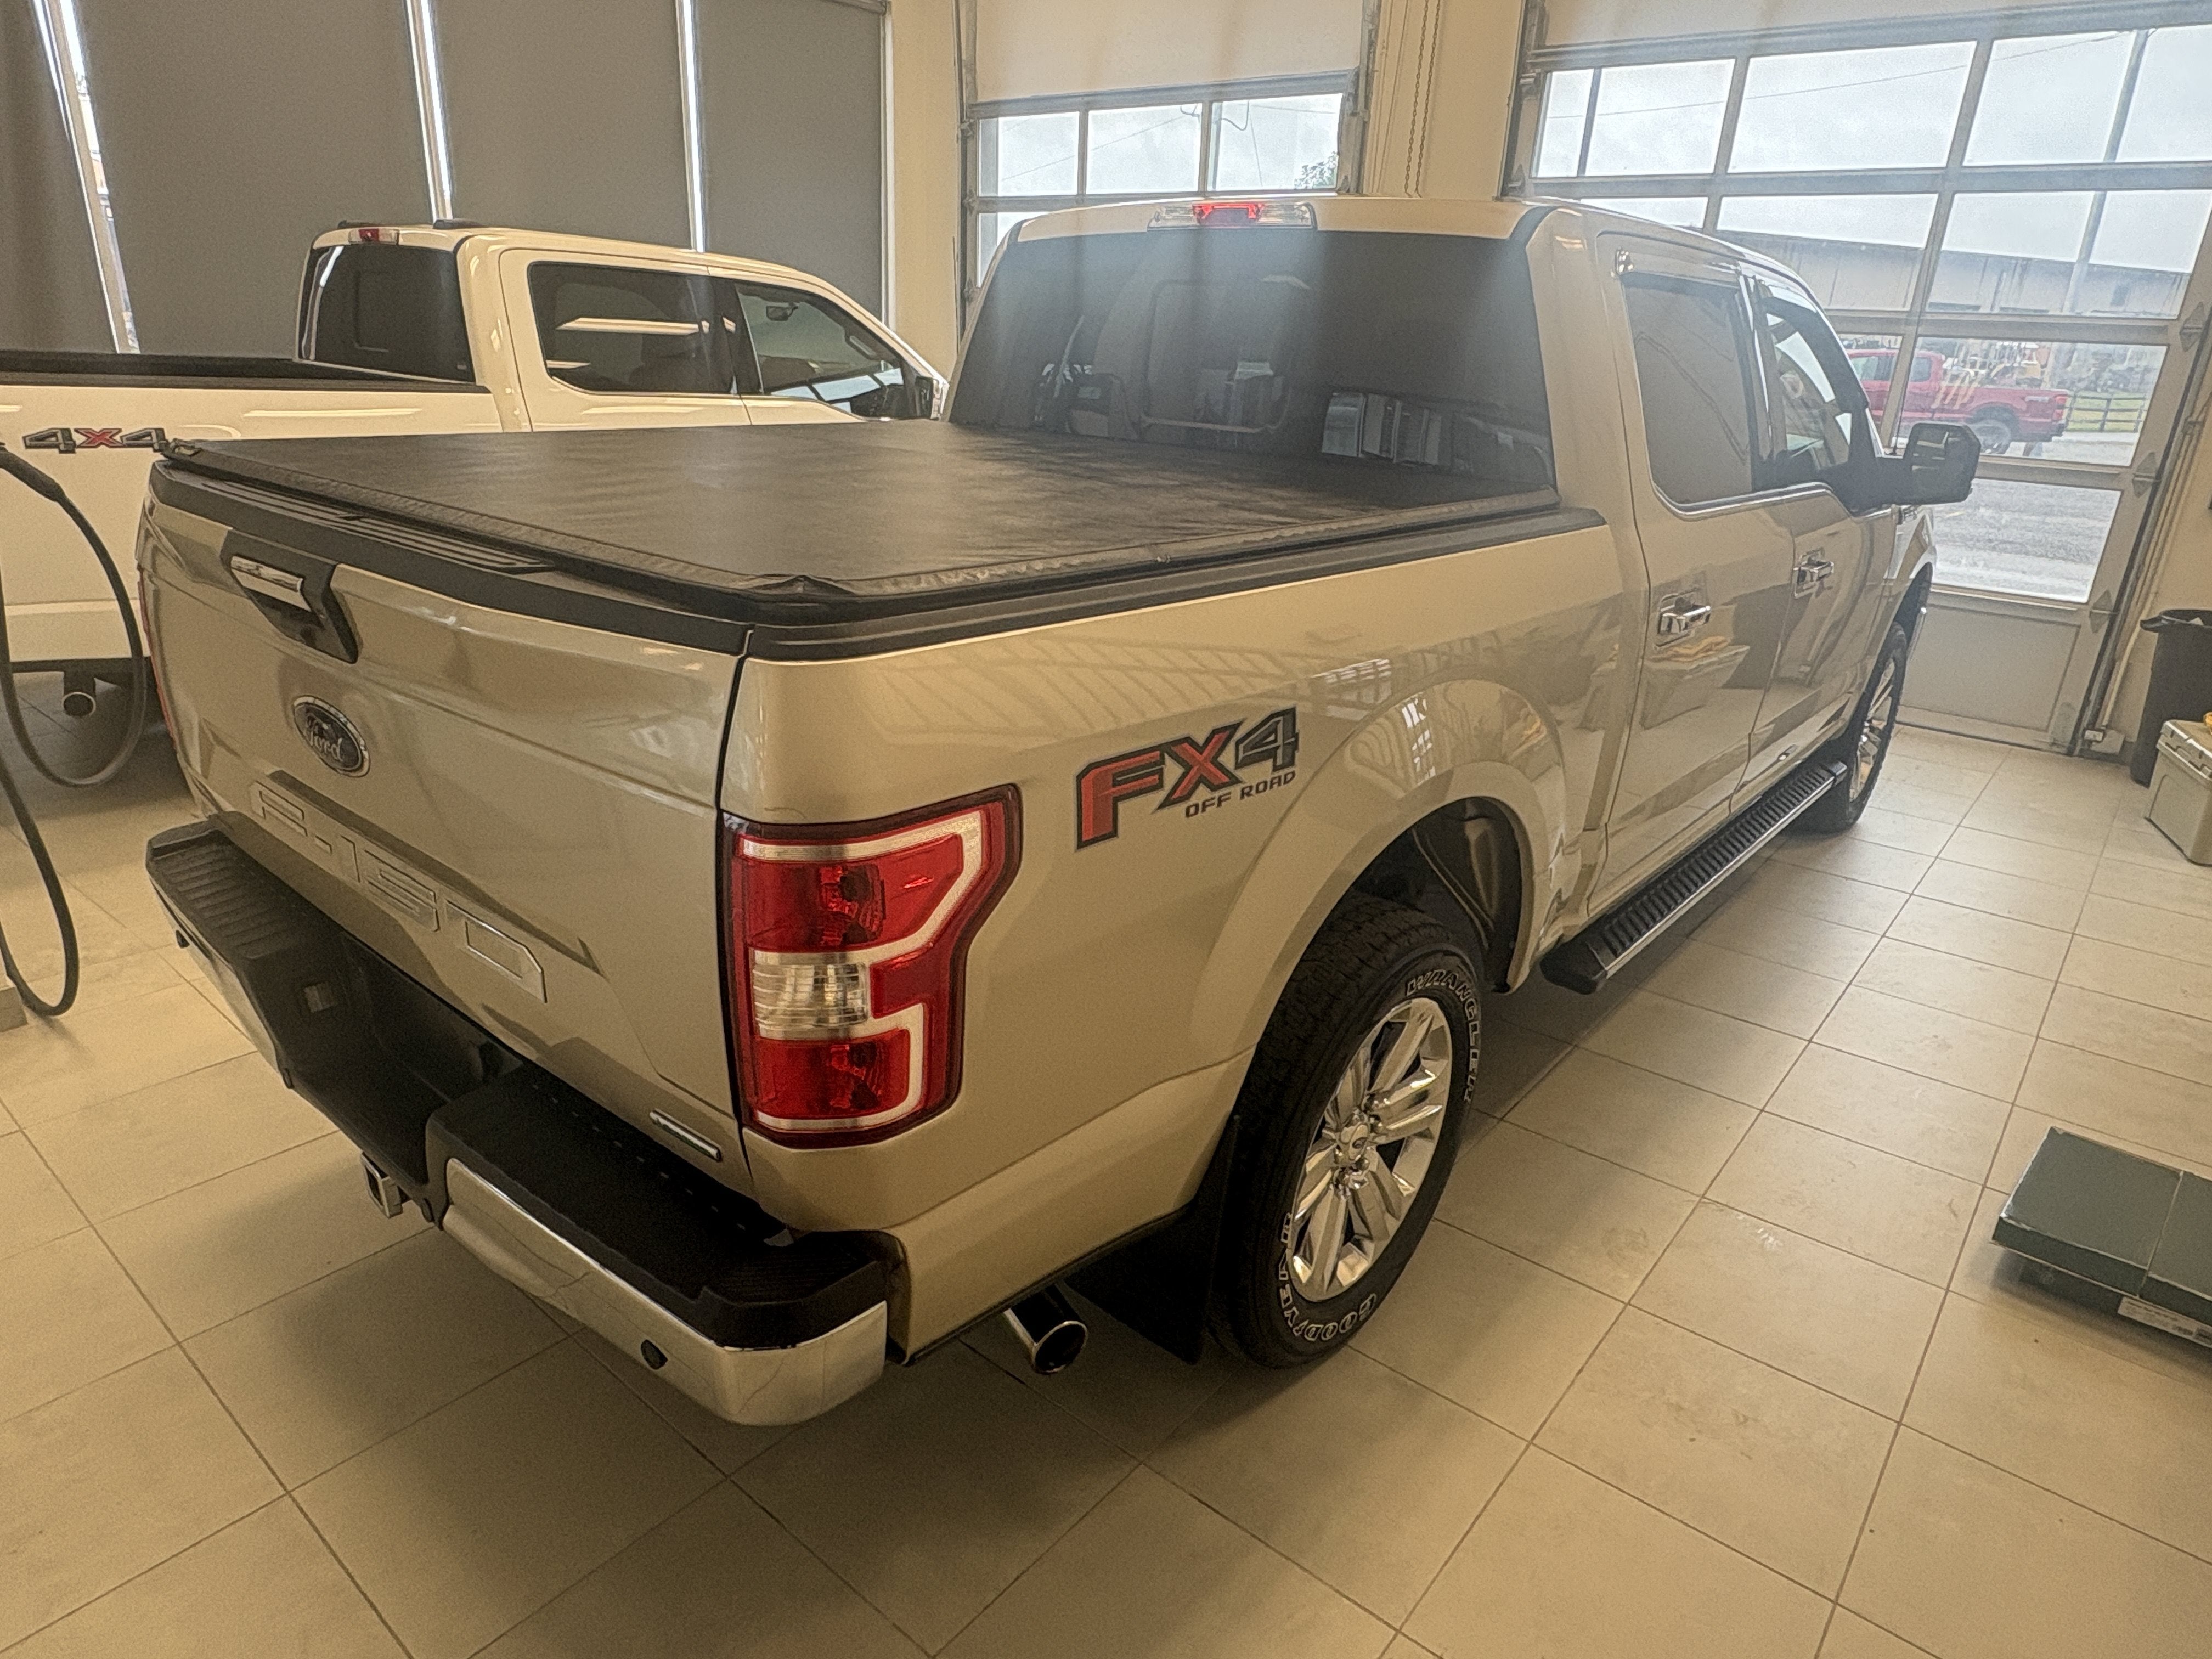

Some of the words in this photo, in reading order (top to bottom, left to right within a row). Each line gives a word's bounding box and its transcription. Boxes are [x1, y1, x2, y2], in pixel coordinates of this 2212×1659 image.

[1076, 707, 1299, 851] FX4
[1185, 792, 1232, 818] OFF
[1240, 770, 1296, 800] ROAD
[249, 780, 547, 1003] F-150
[1278, 1212, 1377, 1342] GOODYEAR
